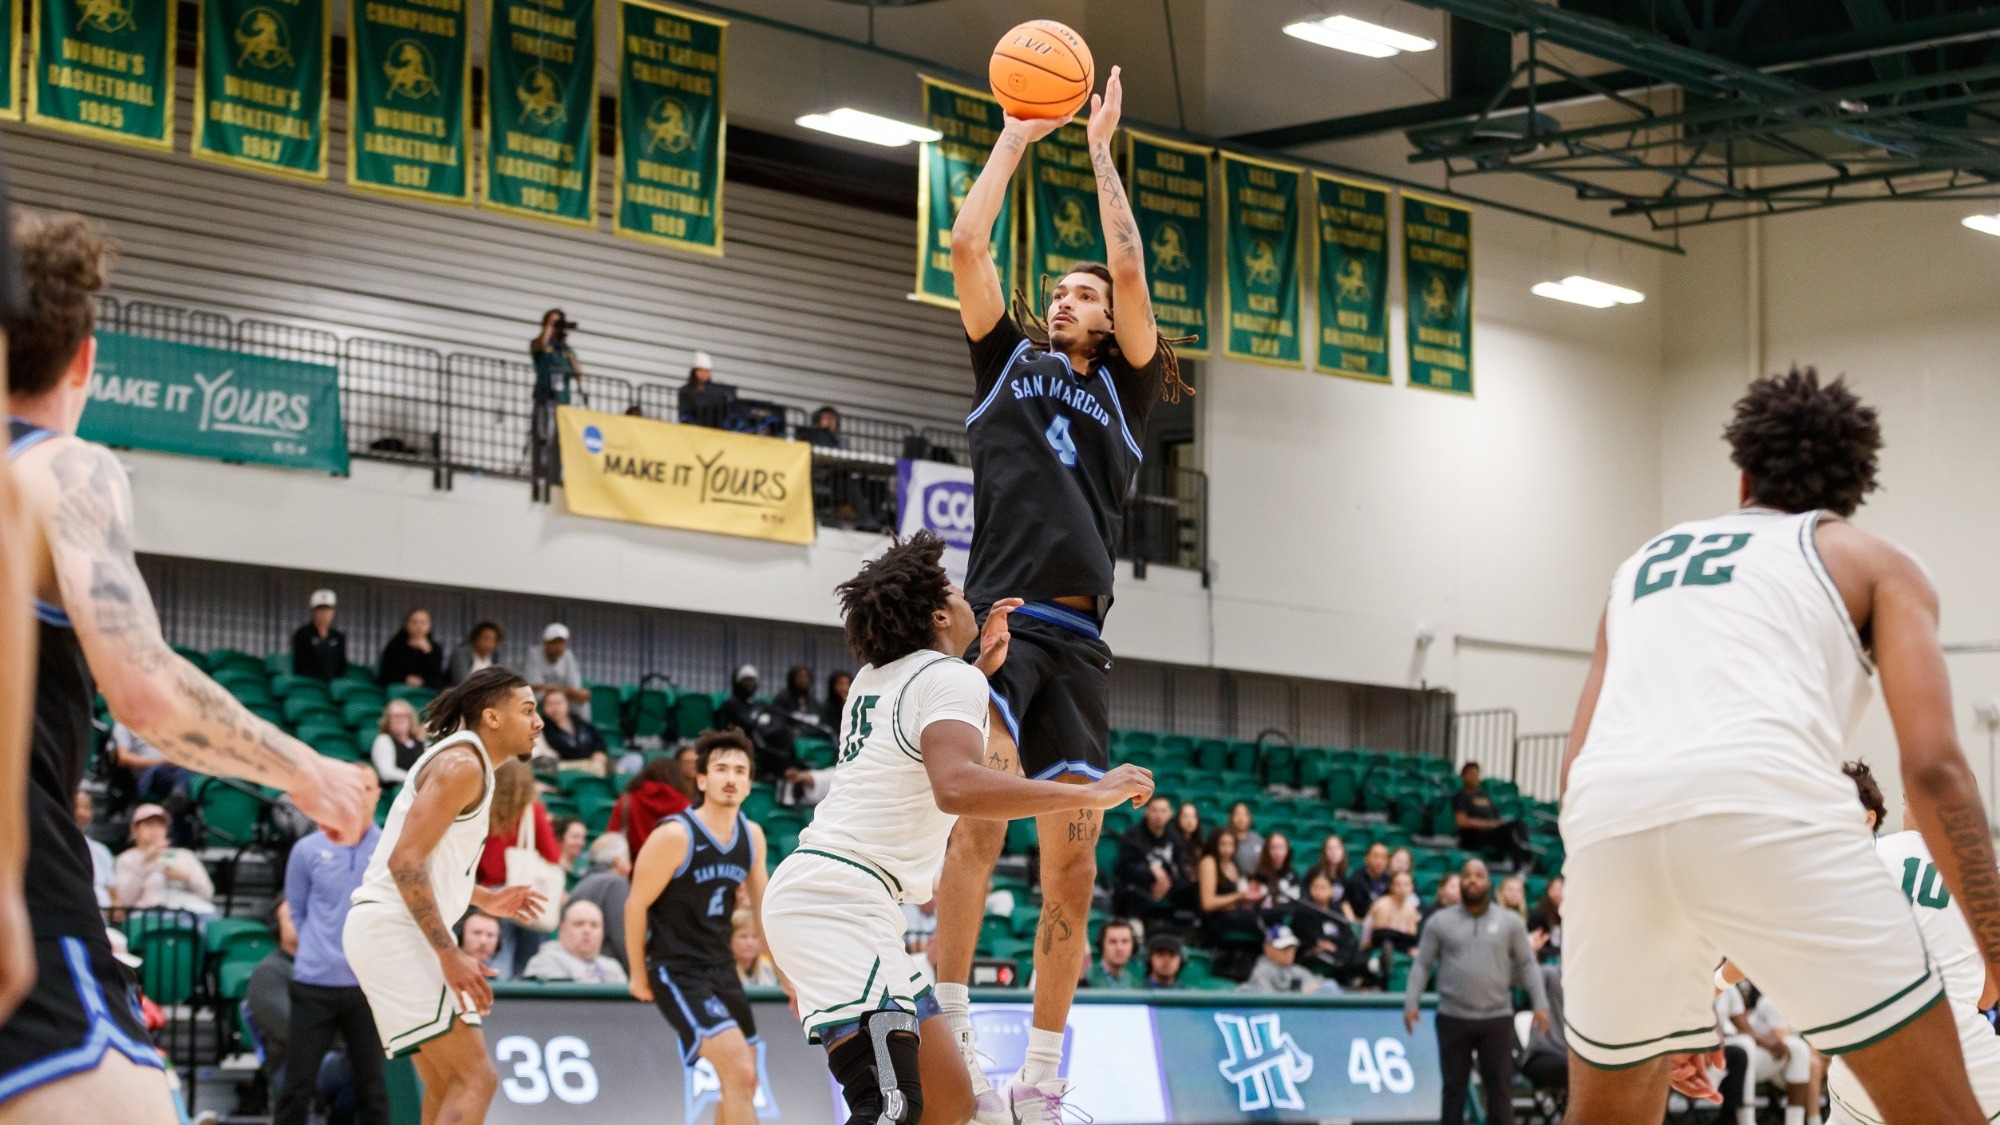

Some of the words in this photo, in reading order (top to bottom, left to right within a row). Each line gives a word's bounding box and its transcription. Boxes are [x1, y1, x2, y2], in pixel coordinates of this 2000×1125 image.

[62, 37, 145, 76] WOMEN'S
[48, 63, 154, 107] BASKETBALL
[224, 74, 300, 112] WOMEN'S
[210, 100, 311, 142] BASKETBALL
[373, 106, 447, 139] WOMEN'S
[364, 132, 458, 167] BASKETBALL
[507, 131, 574, 163] WOMEN'S
[496, 155, 583, 191] BASKETBALL
[637, 159, 700, 191] WOMEN'S
[626, 181, 710, 218] BASKETBALL
[87, 373, 161, 409] MAKE
[164, 383, 194, 413] IT
[194, 368, 309, 432] YOURS
[1010, 375, 1044, 400] SAN
[1045, 413, 1077, 468] 4
[603, 454, 667, 484] MAKE
[672, 464, 695, 487] IT
[695, 450, 787, 503] YOURS
[1633, 532, 1754, 604] 22
[838, 694, 881, 763] 15
[1901, 856, 1951, 910] 10
[495, 1035, 599, 1105] 36
[1347, 1037, 1416, 1094] 46
